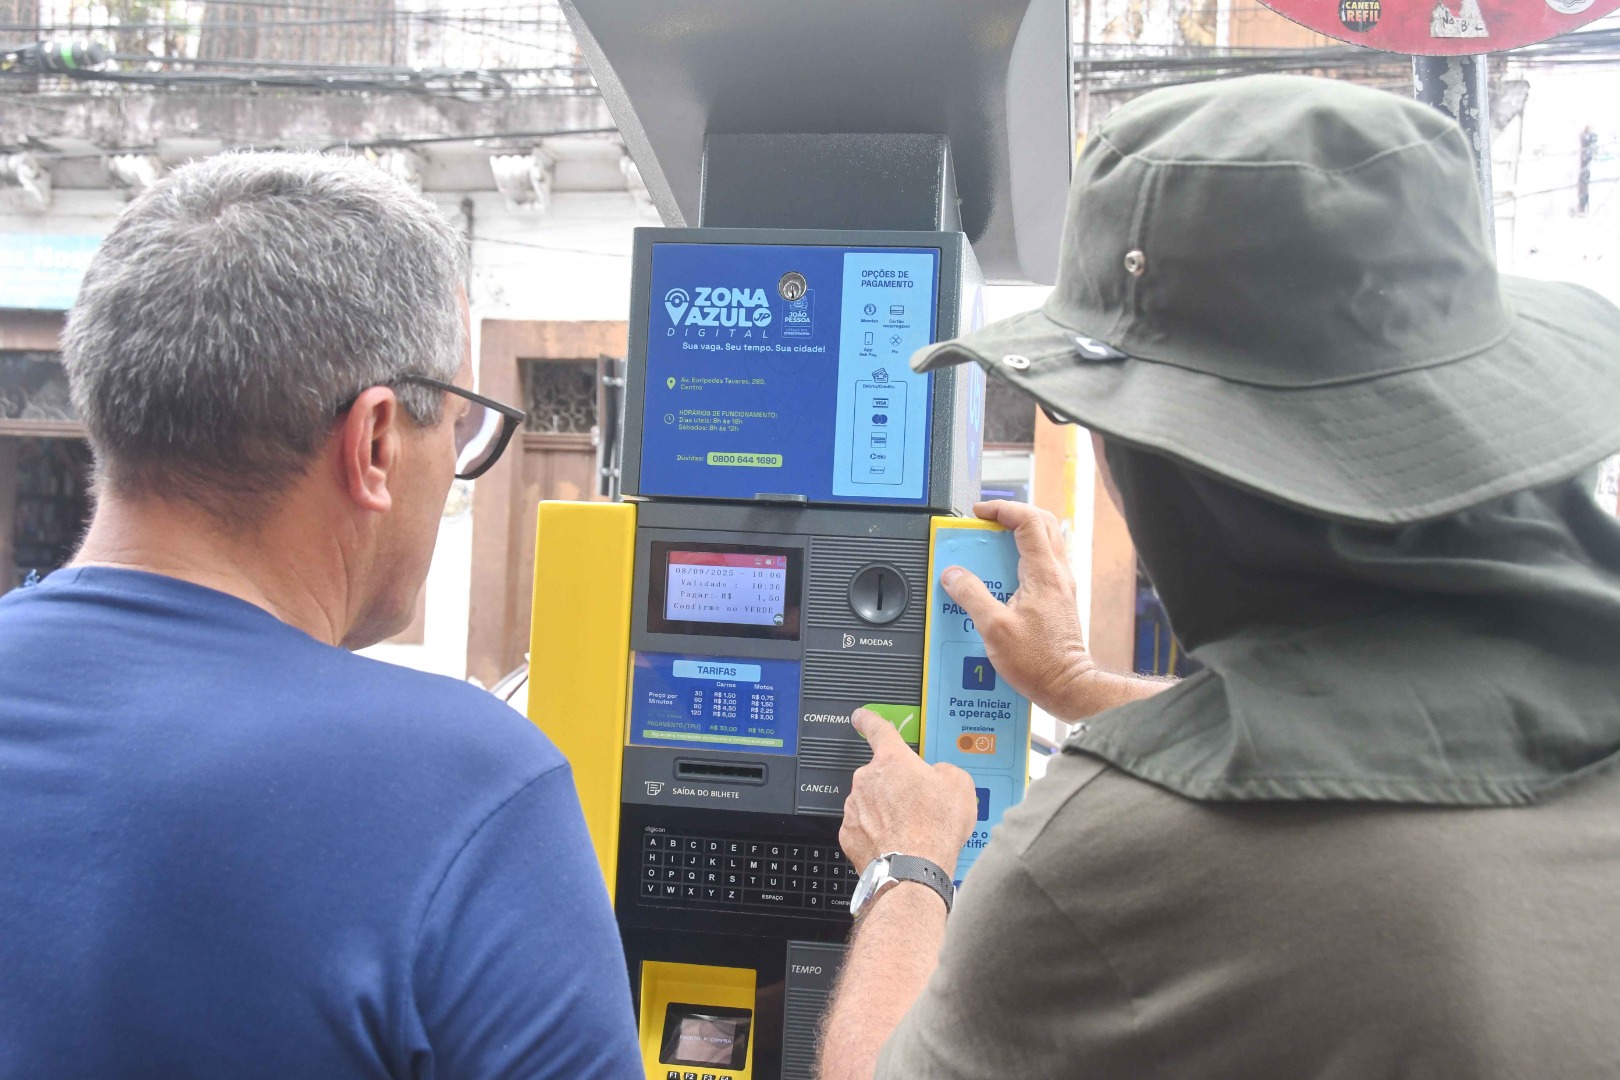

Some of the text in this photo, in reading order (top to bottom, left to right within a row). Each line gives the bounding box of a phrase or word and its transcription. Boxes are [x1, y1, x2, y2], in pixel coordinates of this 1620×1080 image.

[1346, 2, 1380, 10] CANETA
[1346, 10, 1380, 22] REFIL
[861, 269, 896, 279] OPÇÕES
[861, 280, 914, 288] PAGAMENTO
[694, 287, 770, 308] ZONA
[684, 307, 752, 327] AZUL
[667, 328, 768, 338] DIGITAL
[726, 343, 742, 351] Seu
[744, 344, 774, 352] tempo.
[756, 456, 777, 464] 1690
[676, 568, 734, 576] 08/09/2025
[681, 580, 726, 588] Validade
[744, 606, 774, 614] VERDE
[860, 638, 893, 646] MOEDAS
[697, 666, 736, 676] TARIFAS
[974, 665, 984, 682] 1
[950, 698, 1012, 708] Para iniciar
[804, 714, 850, 724] CONFIRMA
[959, 710, 1011, 720] operação
[672, 787, 696, 796] SAÍDA
[711, 790, 740, 798] BILHETE
[800, 784, 839, 794] CANCELA
[792, 964, 822, 974] TEMPO
